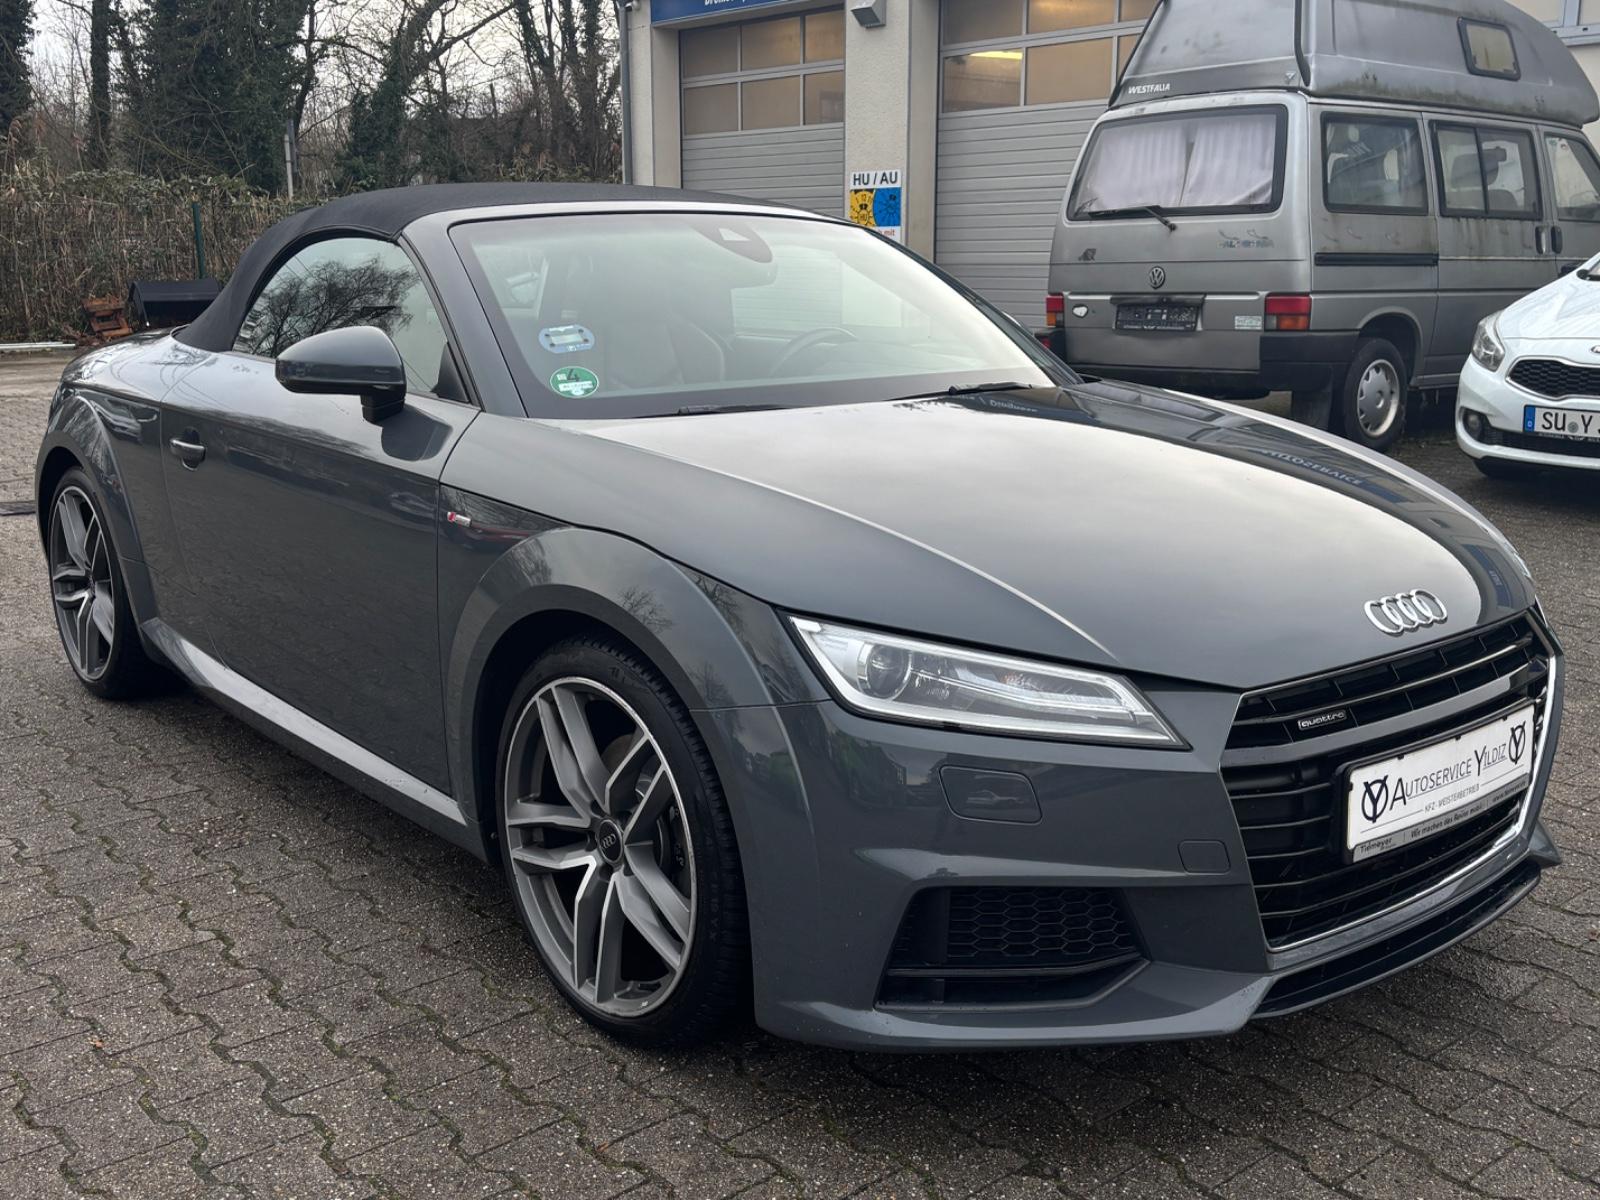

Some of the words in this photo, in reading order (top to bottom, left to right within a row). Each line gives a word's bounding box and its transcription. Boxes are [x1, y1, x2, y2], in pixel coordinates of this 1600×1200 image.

[1128, 83, 1170, 94] WESTFALIA
[853, 173, 870, 186] HU
[880, 171, 898, 184] AU
[567, 368, 580, 382] 4
[1541, 411, 1566, 432] SU
[1580, 414, 1593, 434] Y
[1300, 711, 1345, 728] quattro
